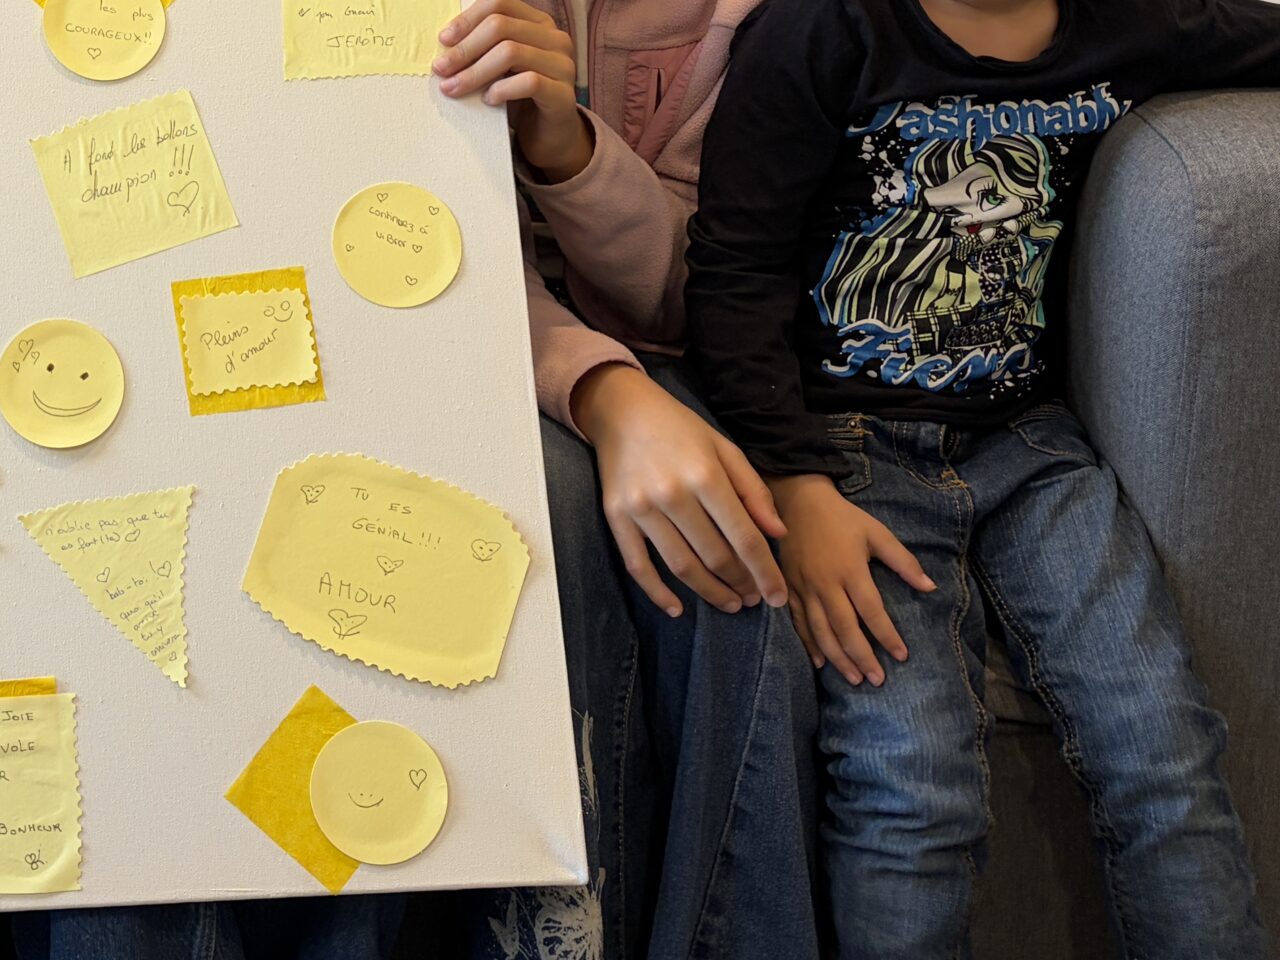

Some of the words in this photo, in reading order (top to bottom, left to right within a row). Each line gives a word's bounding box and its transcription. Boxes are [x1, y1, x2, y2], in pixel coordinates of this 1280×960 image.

[99, 0, 117, 14] les
[132, 7, 154, 22] plus
[63, 148, 72, 174] A
[88, 137, 115, 176] fond
[80, 168, 157, 204] champion
[199, 320, 249, 351] Pleins
[388, 502, 413, 515] ES
[98, 519, 119, 531] pas
[126, 514, 150, 528] que
[318, 571, 398, 615] AMOUR
[0, 739, 36, 754] VOLE
